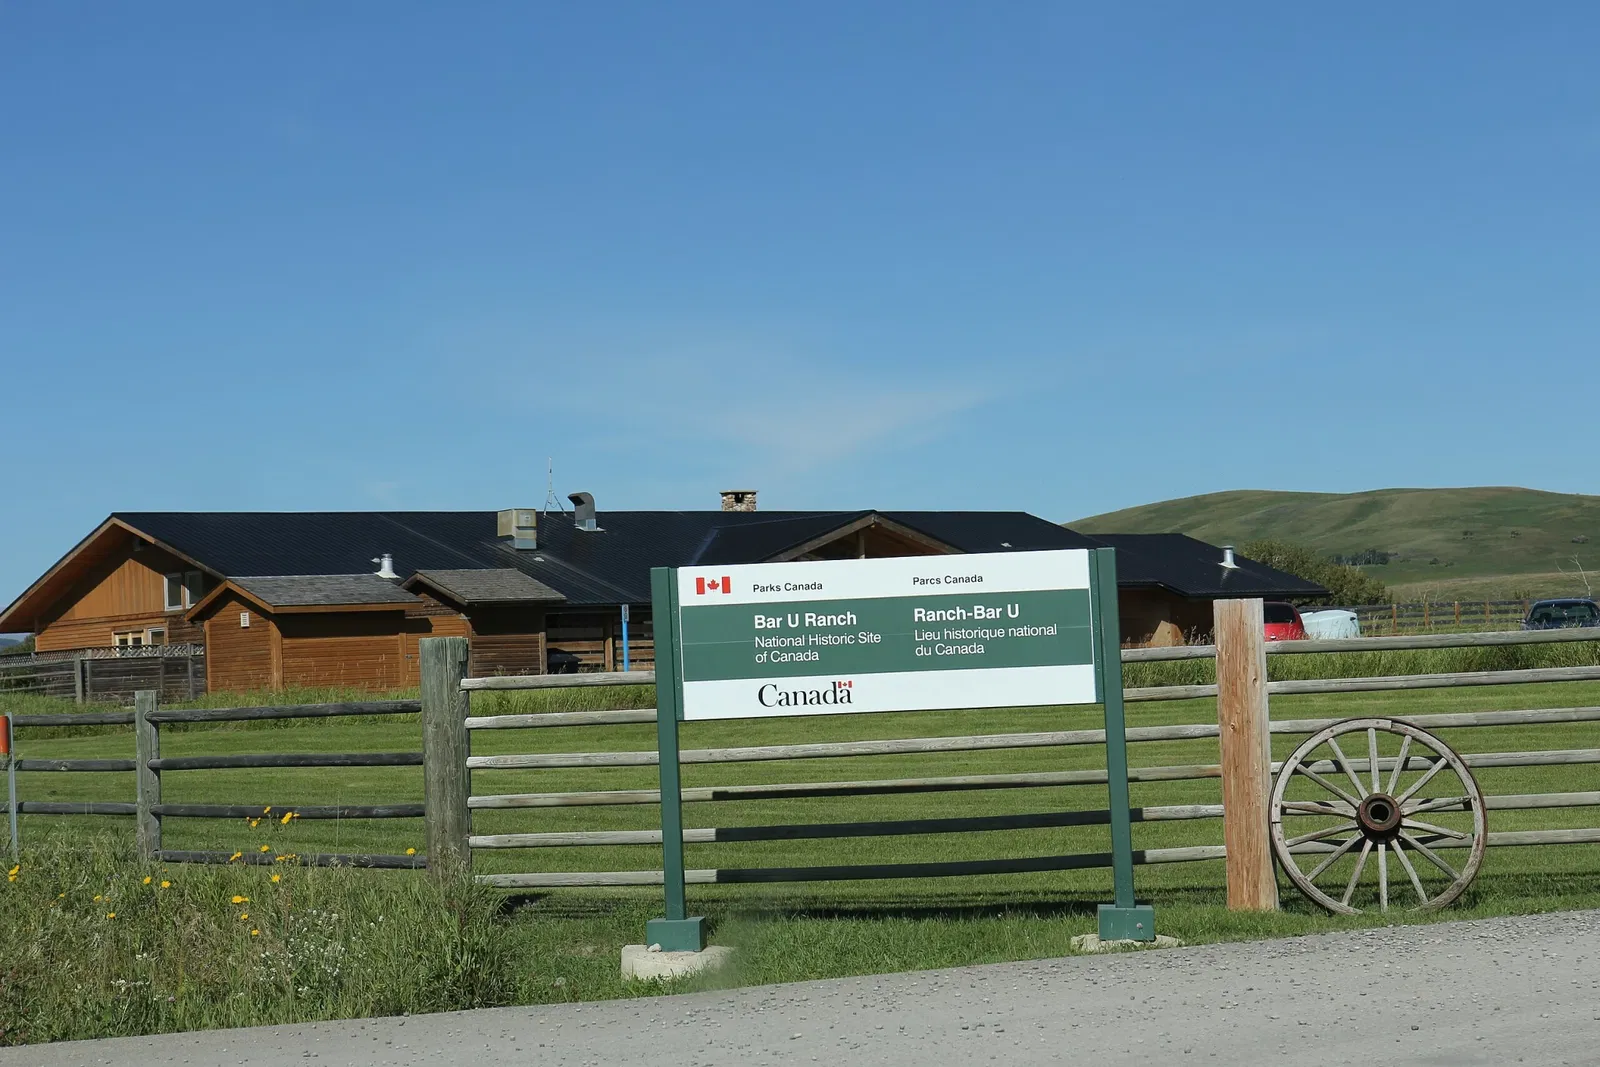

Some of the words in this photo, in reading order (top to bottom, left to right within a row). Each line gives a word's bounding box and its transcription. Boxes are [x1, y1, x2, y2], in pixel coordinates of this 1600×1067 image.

[753, 583, 781, 592] Parks
[784, 582, 823, 591] Canada
[913, 576, 941, 585] Parcs
[944, 574, 983, 584] Canada
[754, 615, 783, 629] Bar
[787, 614, 799, 628] U
[805, 611, 857, 627] Ranch
[914, 605, 1002, 622] Ranch-Bar
[1007, 604, 1020, 618] U
[755, 635, 805, 648] National
[808, 633, 855, 646] Historic
[858, 632, 881, 644] Site
[915, 629, 940, 641] Lieu
[944, 626, 1005, 640] historique
[1009, 624, 1057, 637] national
[755, 652, 768, 663] of
[771, 649, 819, 662] Canada
[915, 644, 931, 656] du
[935, 643, 985, 655] Canada
[758, 681, 853, 707] Canada
